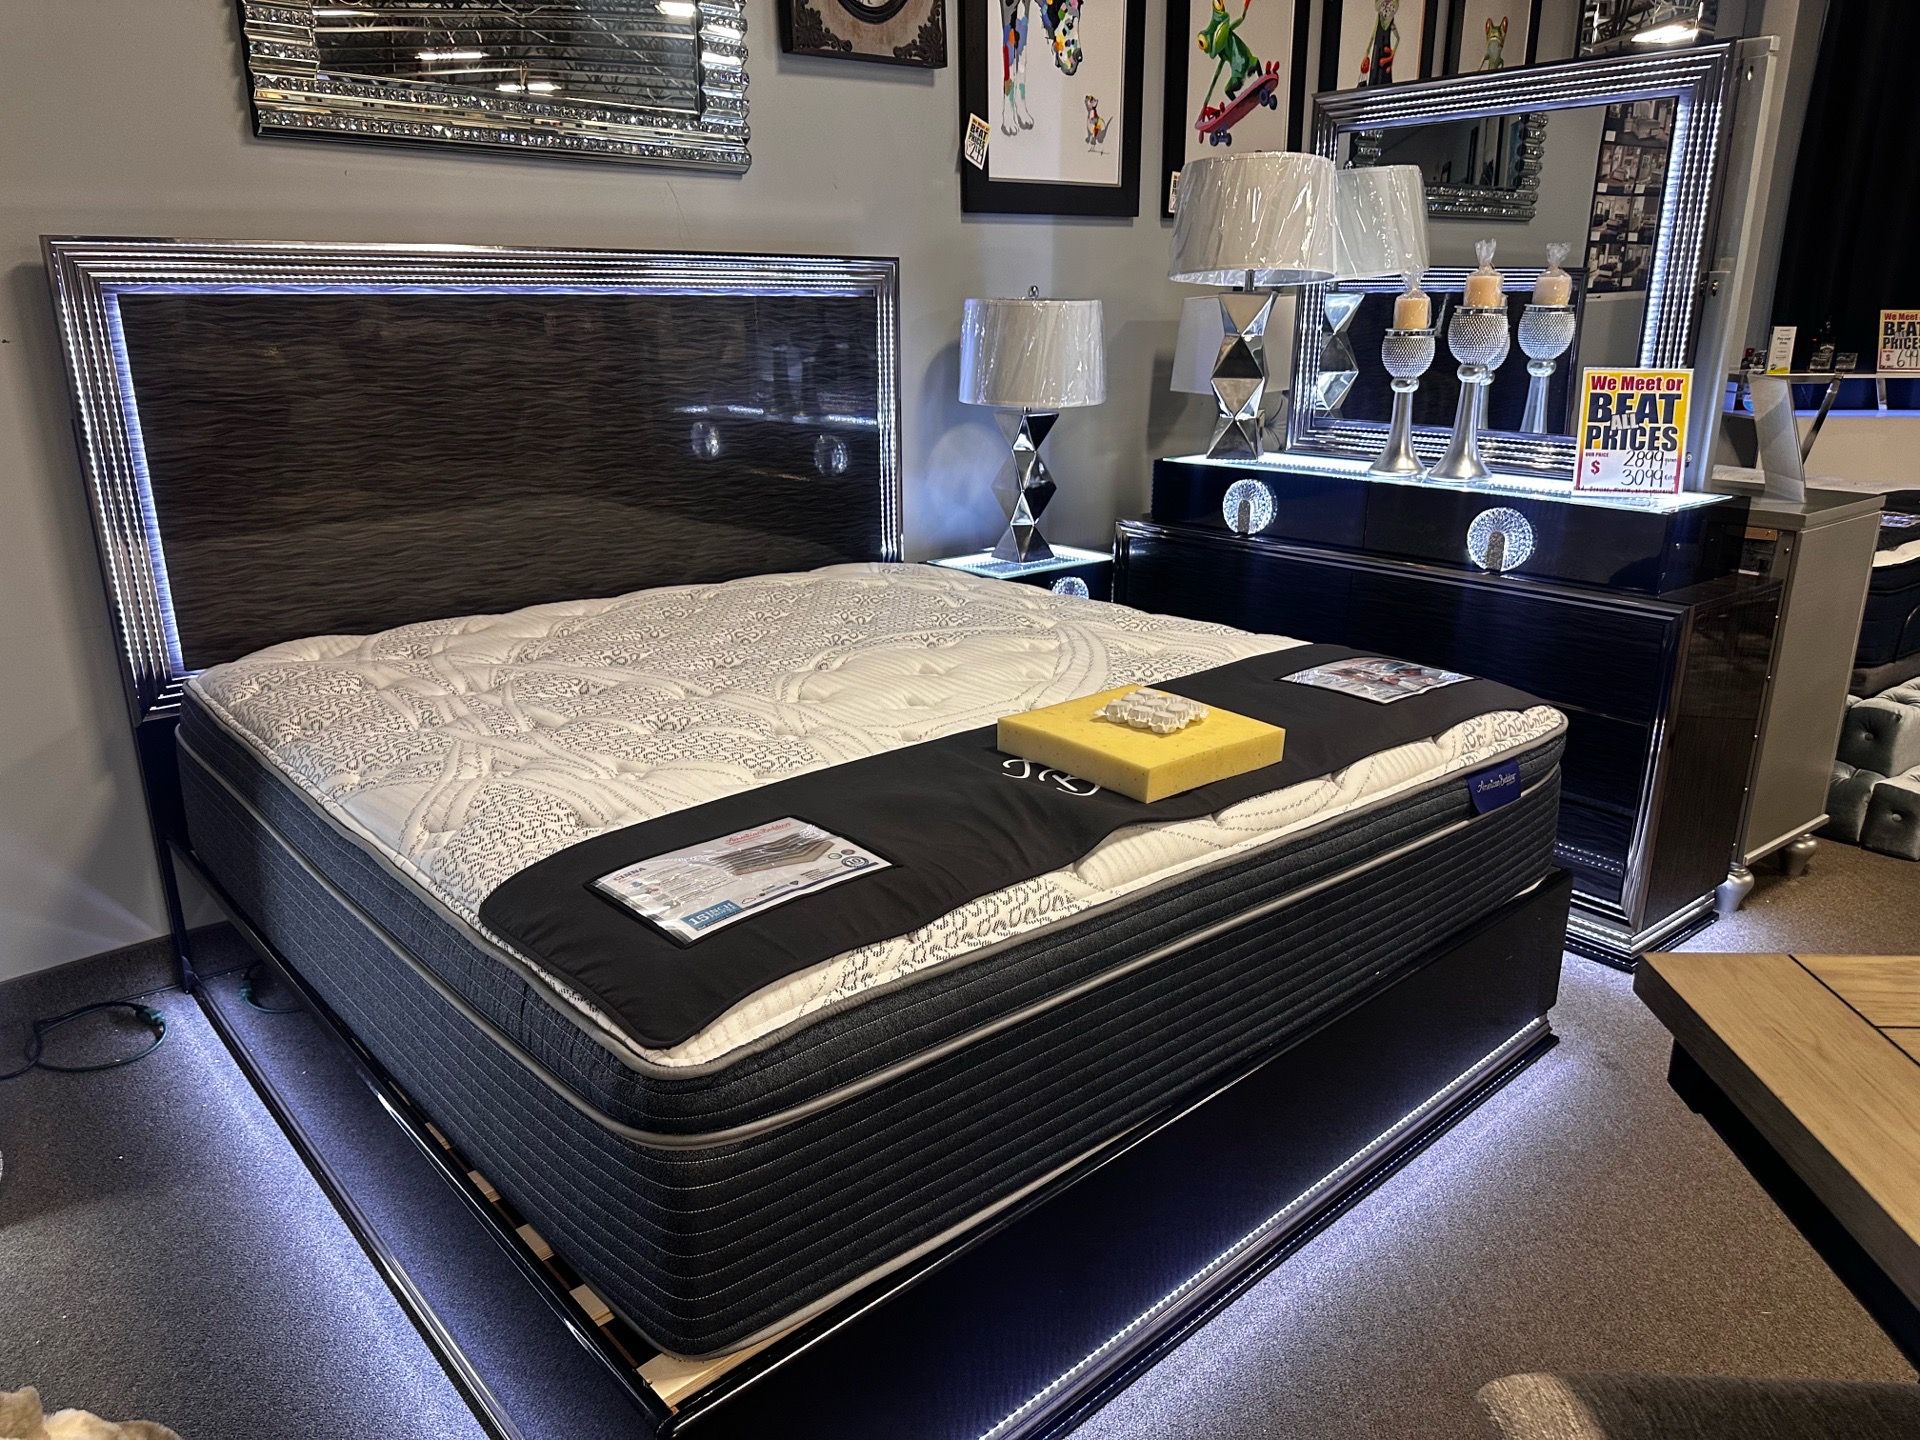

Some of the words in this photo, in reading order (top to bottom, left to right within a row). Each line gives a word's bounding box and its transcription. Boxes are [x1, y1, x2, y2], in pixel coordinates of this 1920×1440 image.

[1882, 337, 1920, 349] PRICE
[1591, 376, 1617, 391] We
[1621, 376, 1662, 391] Meet
[1666, 378, 1684, 391] or
[1588, 393, 1682, 424] BEAT
[1611, 412, 1638, 430] ALL
[1585, 425, 1678, 451] PRICES
[1590, 460, 1601, 475] $
[1624, 450, 1664, 469] 2899
[1621, 469, 1664, 488] 3099
[688, 914, 709, 926] 15
